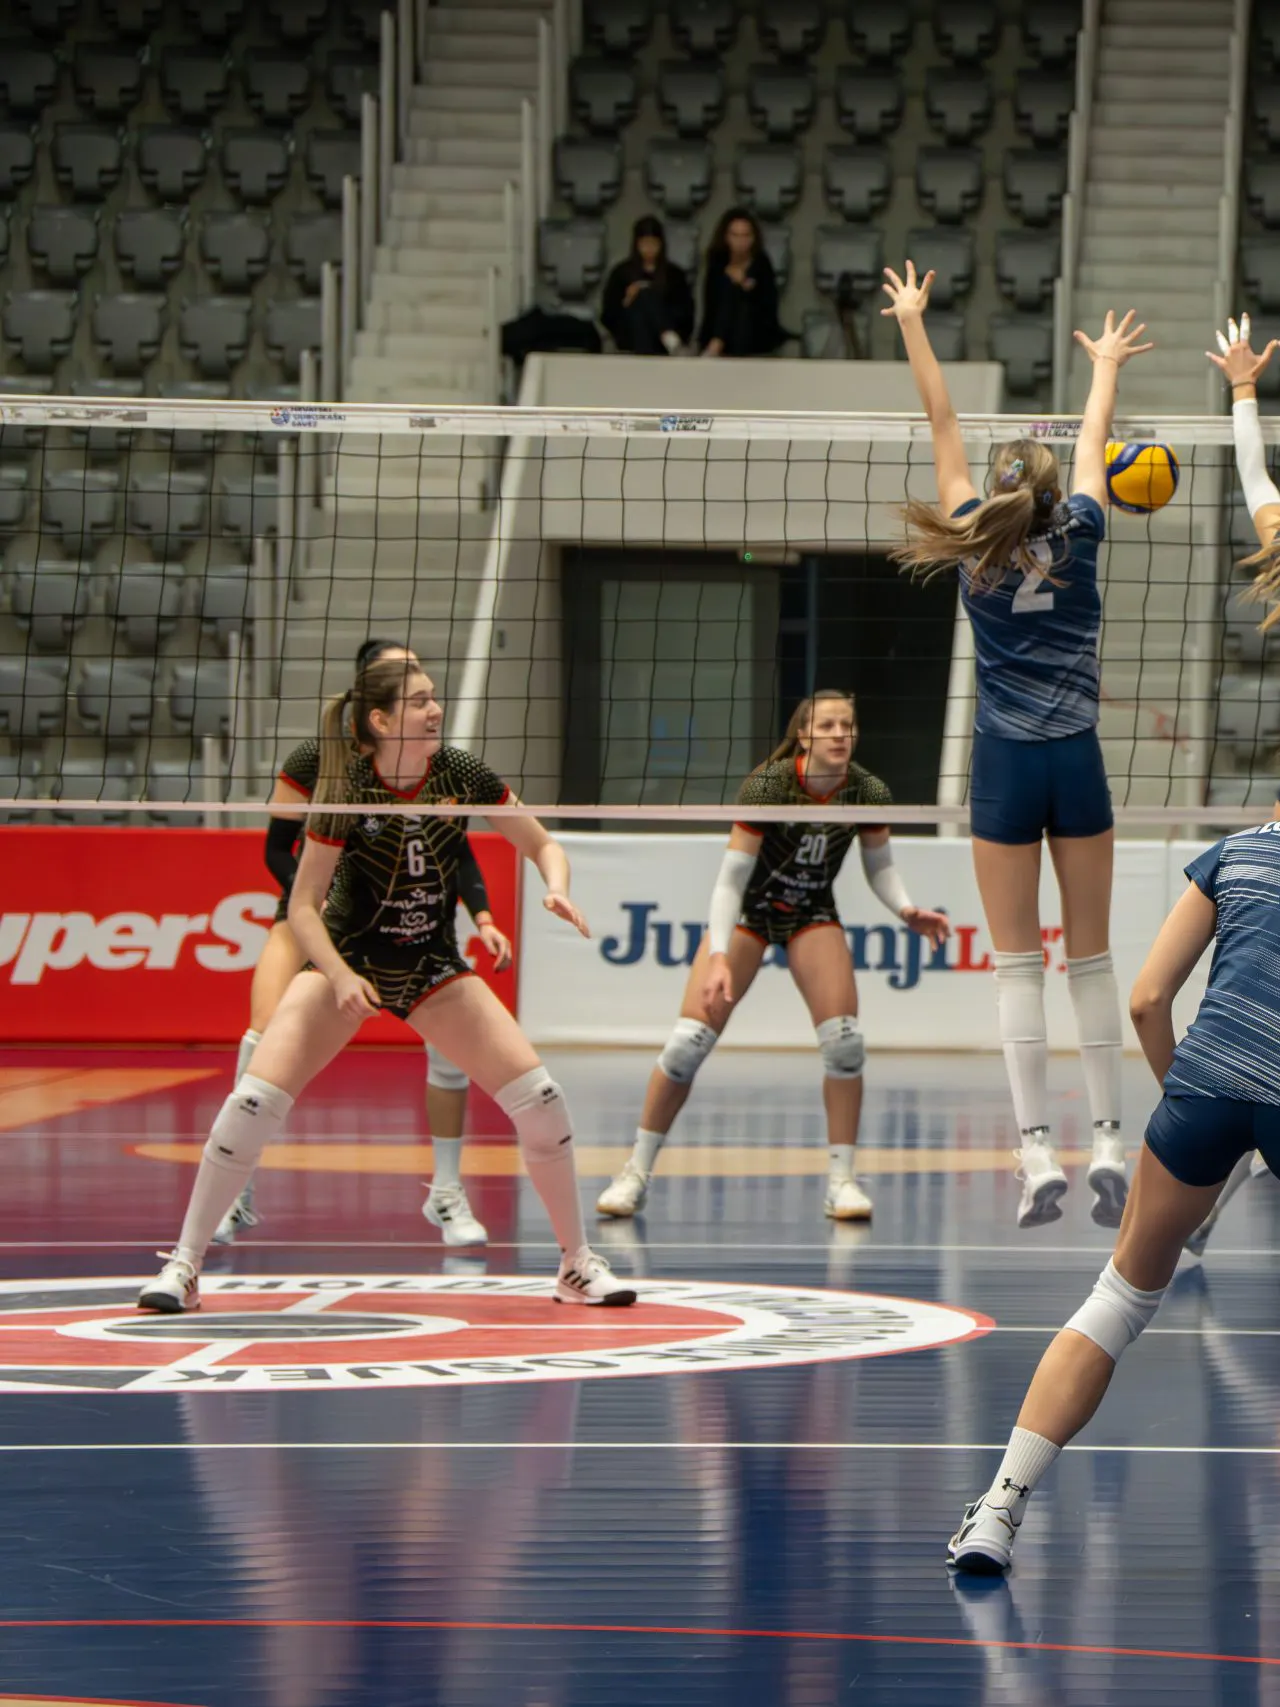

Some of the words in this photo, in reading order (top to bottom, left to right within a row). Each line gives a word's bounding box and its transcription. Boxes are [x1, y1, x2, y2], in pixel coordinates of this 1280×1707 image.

[1010, 539, 1054, 614] 2
[407, 839, 426, 877] 6
[795, 834, 828, 865] 20
[160, 1357, 622, 1383] OSIJEK
